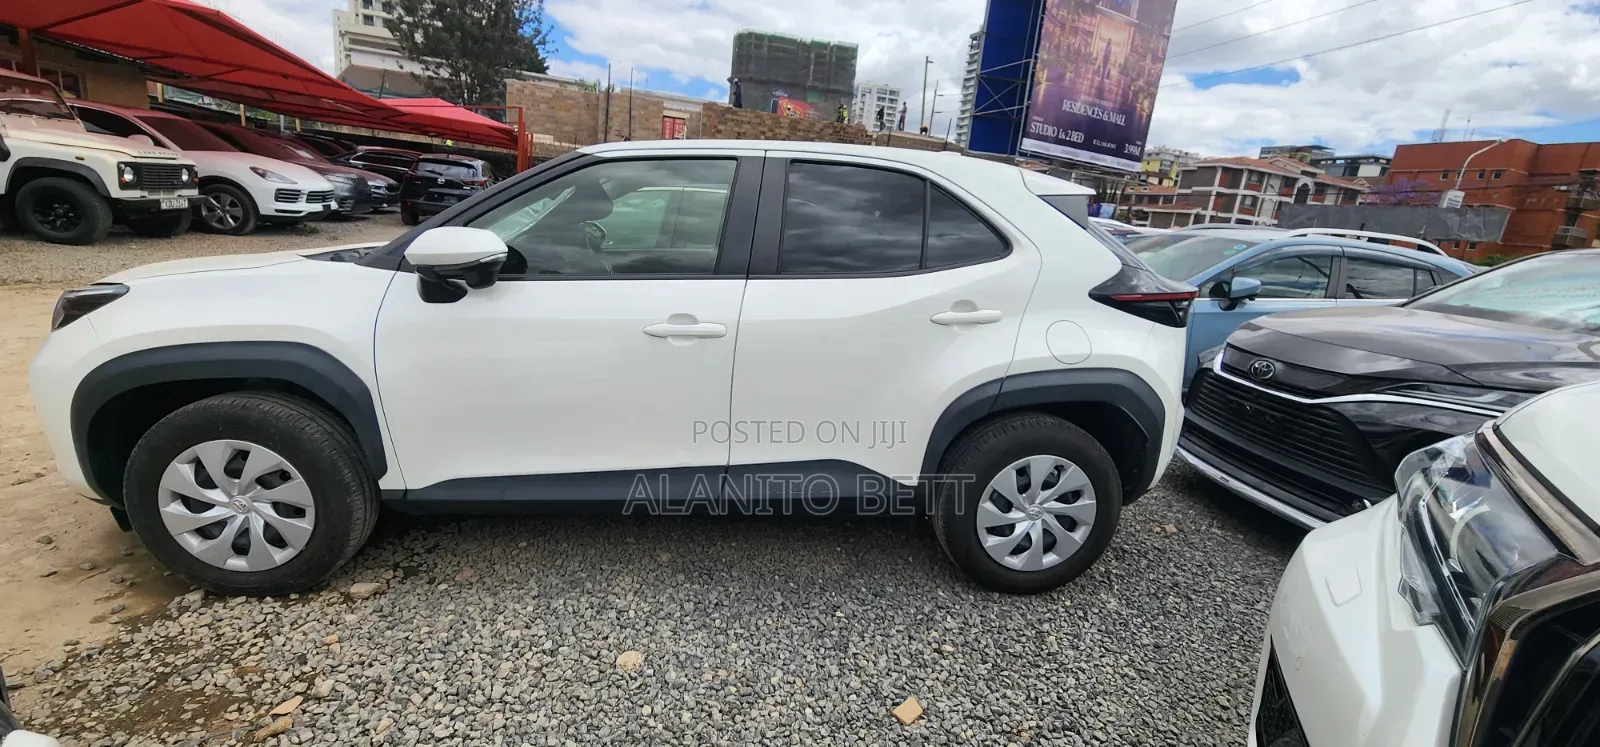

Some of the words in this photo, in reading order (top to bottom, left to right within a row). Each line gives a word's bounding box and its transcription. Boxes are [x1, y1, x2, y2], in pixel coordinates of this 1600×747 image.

[1062, 99, 1103, 120] RESIDENCES
[1109, 112, 1126, 126] MALL
[1030, 122, 1058, 137] STUDIO
[1071, 131, 1084, 143] BED
